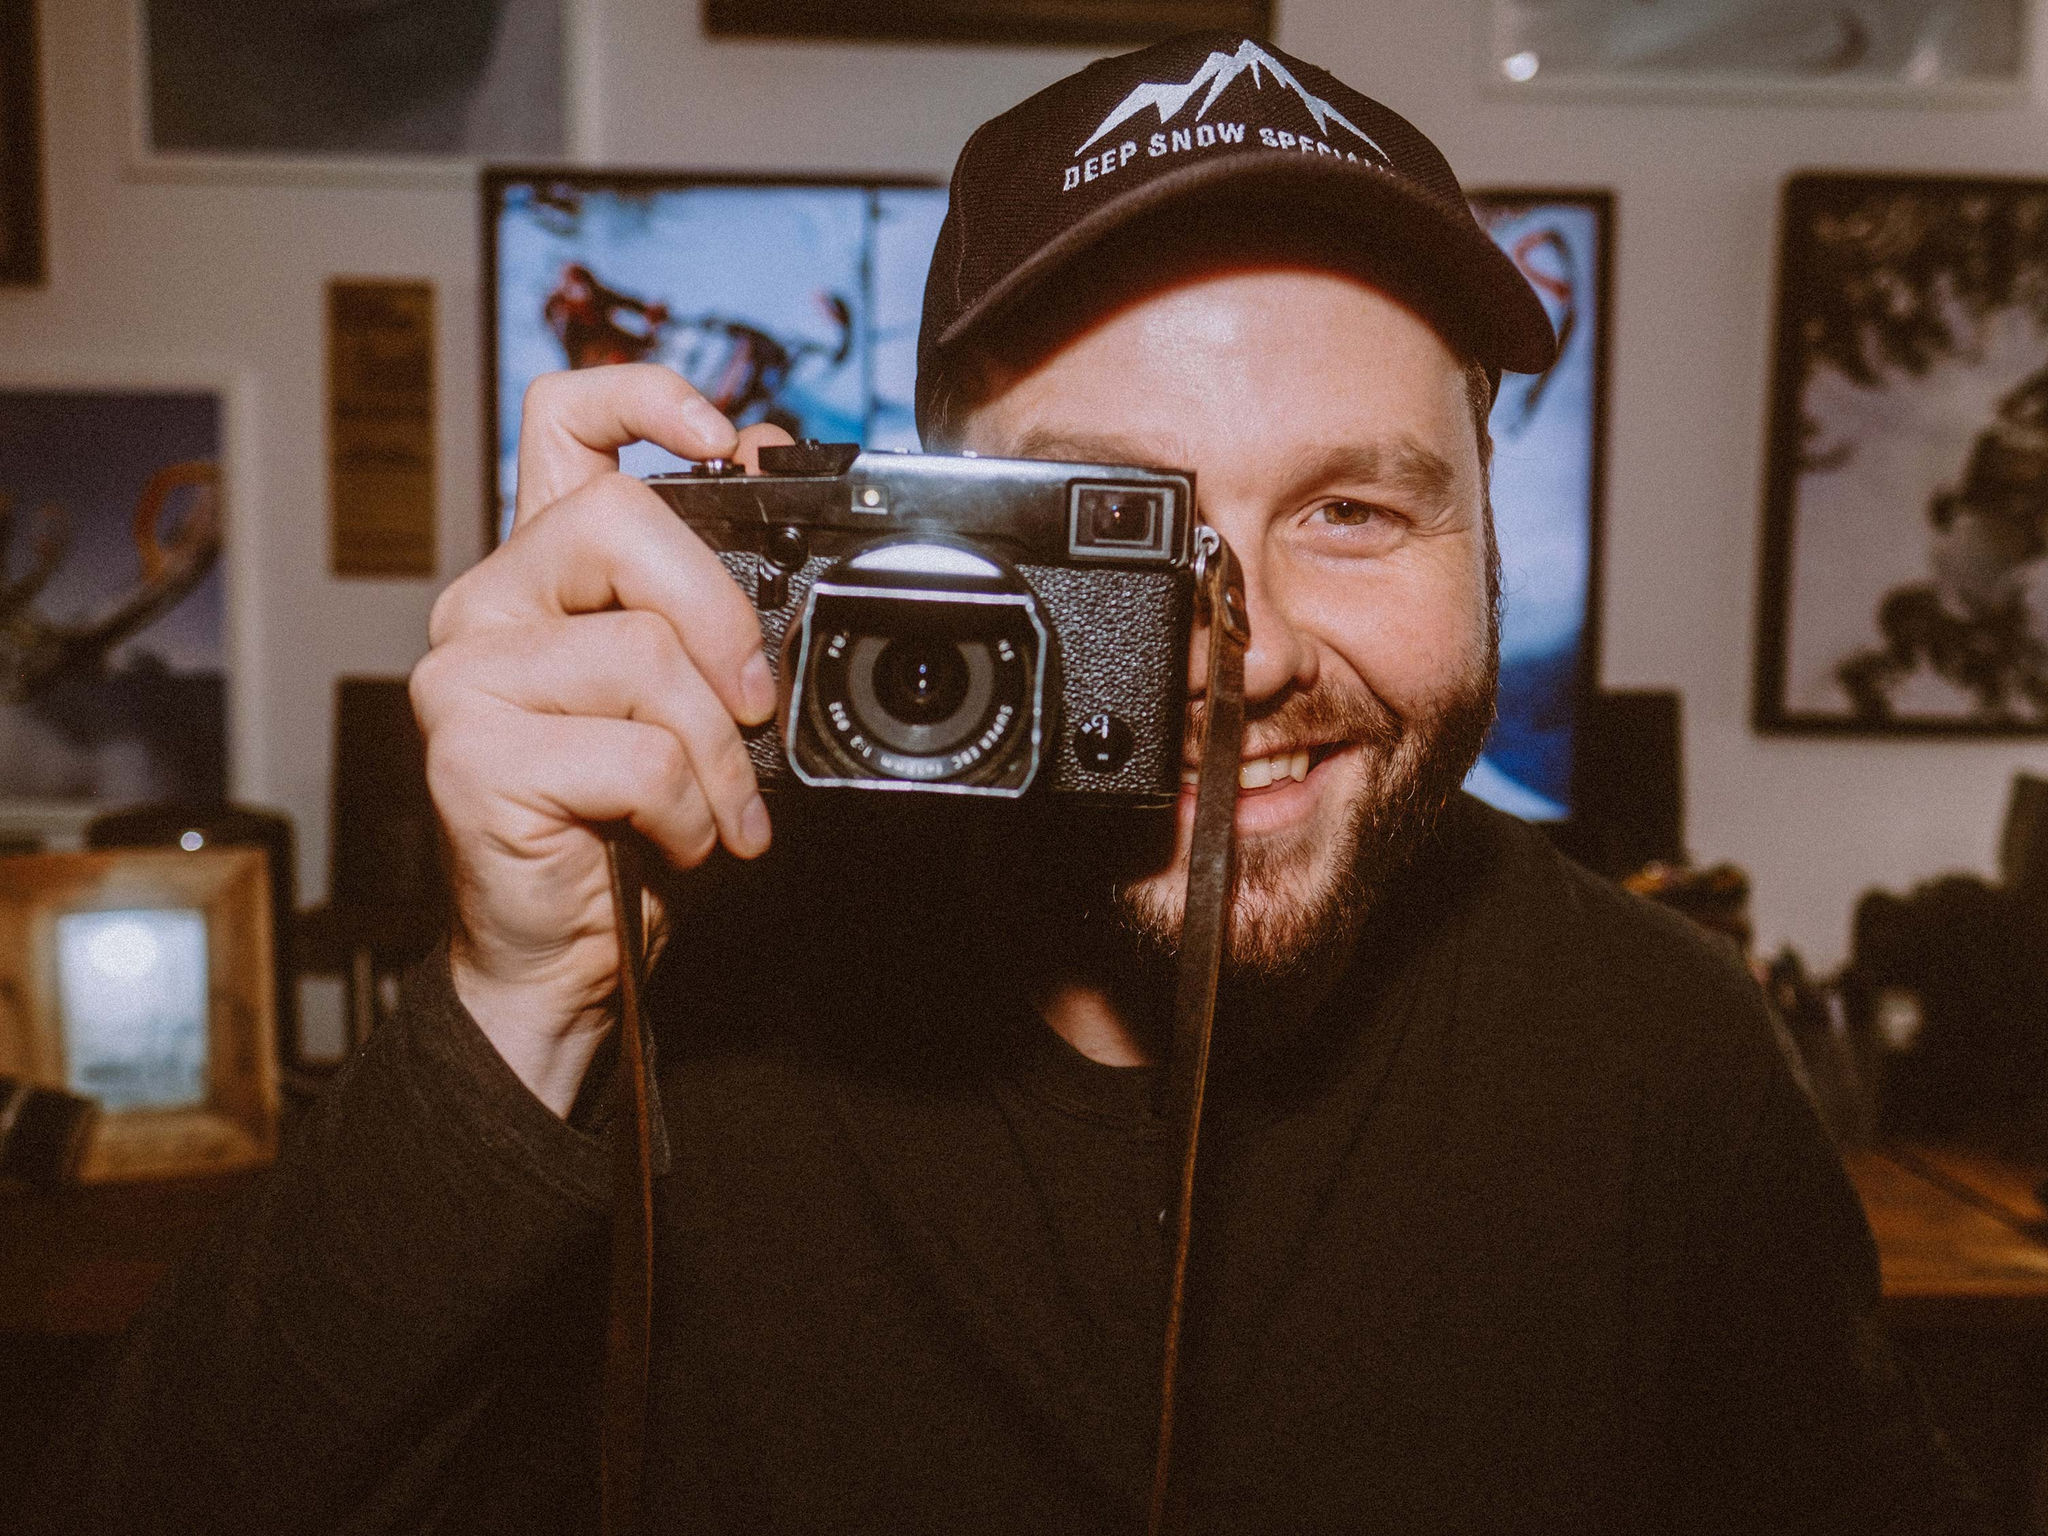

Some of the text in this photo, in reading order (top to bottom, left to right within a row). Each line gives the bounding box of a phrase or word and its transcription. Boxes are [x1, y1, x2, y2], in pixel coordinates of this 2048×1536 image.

[1063, 140, 1137, 191] DEEP
[1148, 122, 1245, 156] SNOW
[980, 704, 1013, 749] SUPER
